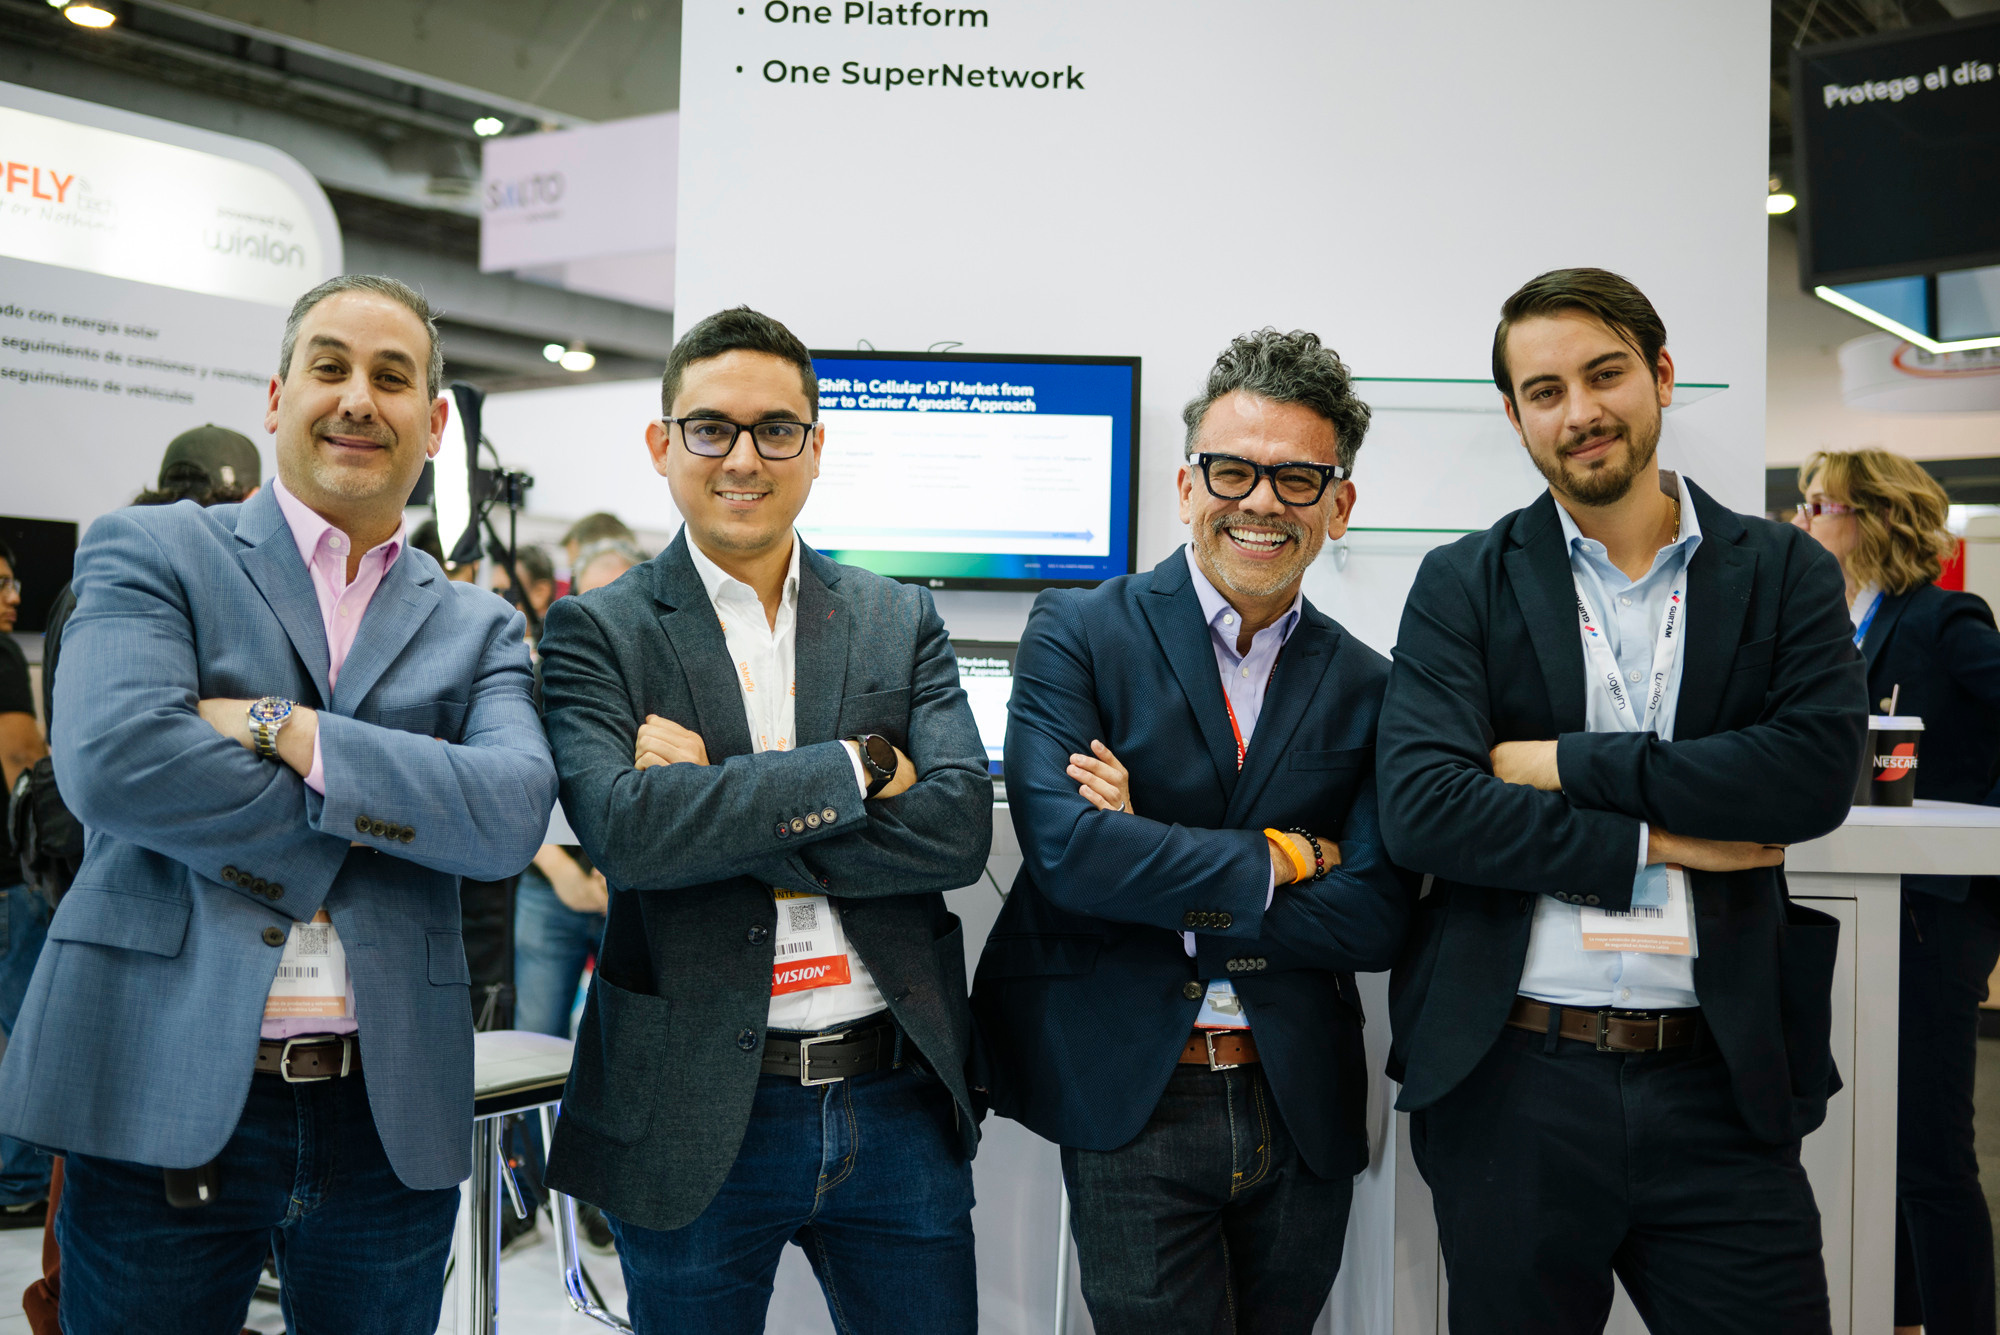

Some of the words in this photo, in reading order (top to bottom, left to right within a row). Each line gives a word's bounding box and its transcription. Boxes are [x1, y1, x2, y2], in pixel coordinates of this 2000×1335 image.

[764, 0, 832, 24] One
[844, 1, 988, 28] Platform
[763, 59, 830, 84] One
[841, 61, 1085, 91] SuperNetwork
[1823, 75, 1921, 110] Protege
[1923, 65, 1948, 91] el
[1952, 60, 1994, 86] día
[203, 226, 305, 268] wialon
[28, 309, 57, 323] con
[123, 324, 159, 341] solar
[1, 335, 100, 362] seguimiento
[103, 349, 122, 365] de
[0, 367, 99, 393] seguimiento
[103, 380, 121, 396] de
[818, 378, 852, 393] Shift
[853, 379, 867, 393] in
[869, 379, 924, 394] Cellular
[925, 380, 949, 395] IoT
[951, 381, 999, 396] Market
[1000, 382, 1035, 397] from
[840, 394, 857, 408] to
[858, 394, 906, 409] Carrier
[907, 395, 968, 412] Agnostic
[969, 397, 1037, 413] Approach
[1665, 605, 1678, 638] GURTAM
[957, 656, 988, 668] Market
[987, 657, 1010, 668] from
[969, 666, 1011, 677] Approach
[1606, 672, 1627, 711] wialon
[1649, 672, 1664, 711] wialon
